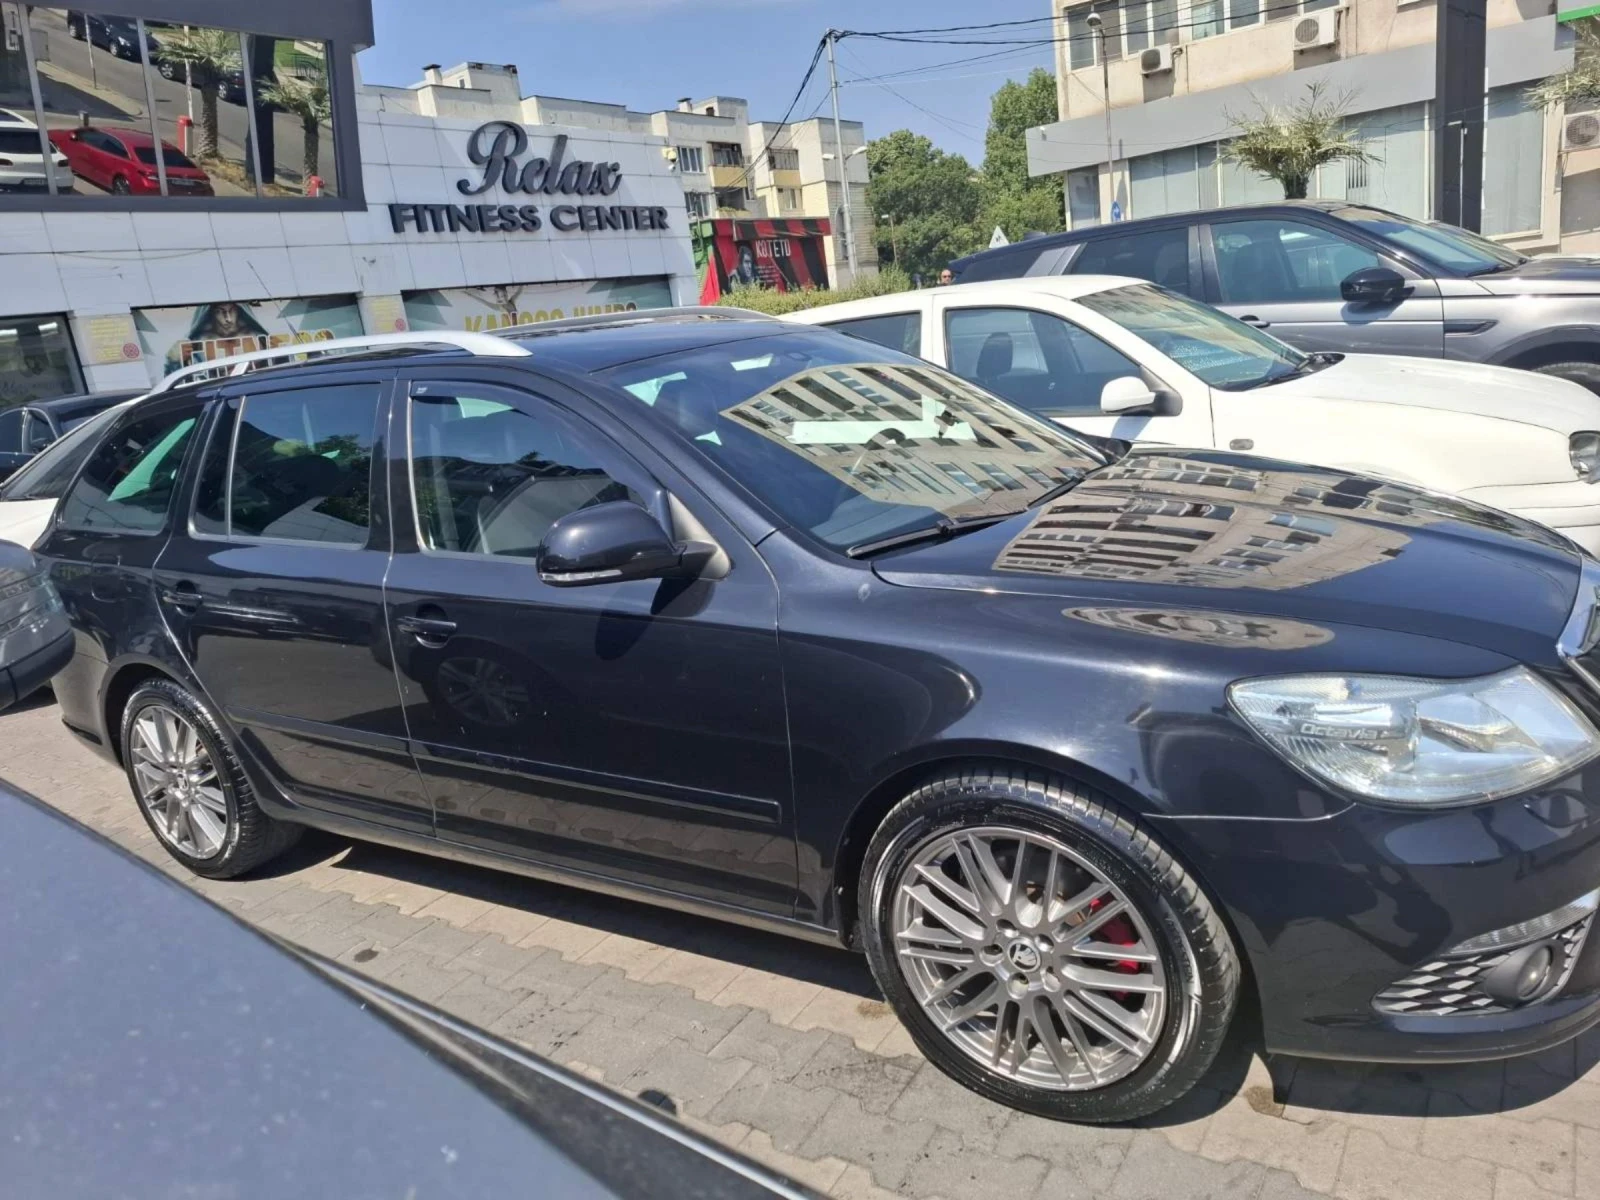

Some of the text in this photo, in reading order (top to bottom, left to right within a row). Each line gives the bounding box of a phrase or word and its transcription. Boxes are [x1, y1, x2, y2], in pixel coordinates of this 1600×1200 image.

[457, 120, 622, 196] Relax
[388, 203, 669, 233] FITNESS CENTER
[1300, 723, 1378, 740] Octavia
